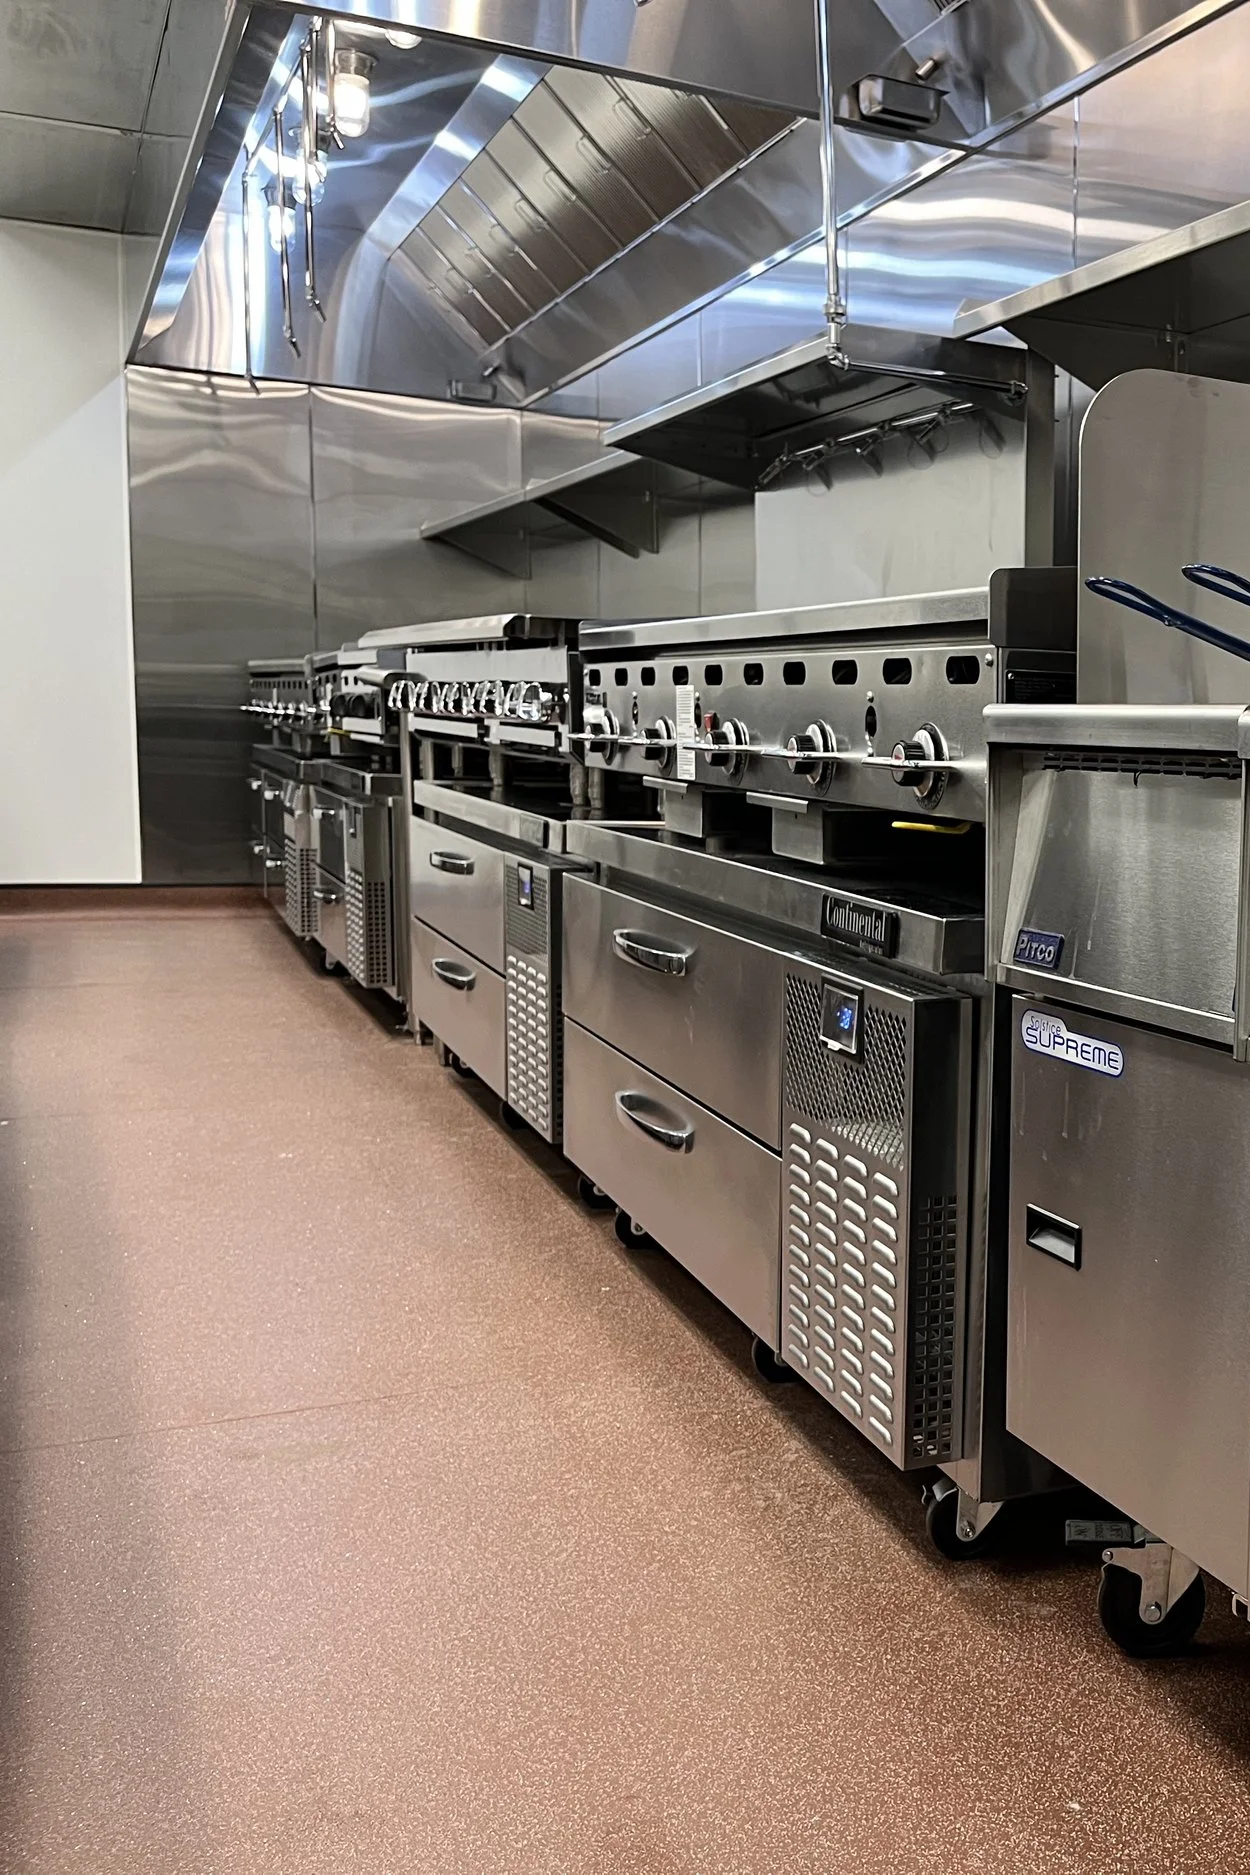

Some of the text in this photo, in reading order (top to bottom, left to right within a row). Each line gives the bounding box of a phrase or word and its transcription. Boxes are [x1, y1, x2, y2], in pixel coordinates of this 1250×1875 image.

[826, 896, 886, 941] Continental
[1030, 1015, 1062, 1036] Solstice
[1025, 1026, 1119, 1071] SUPREME
